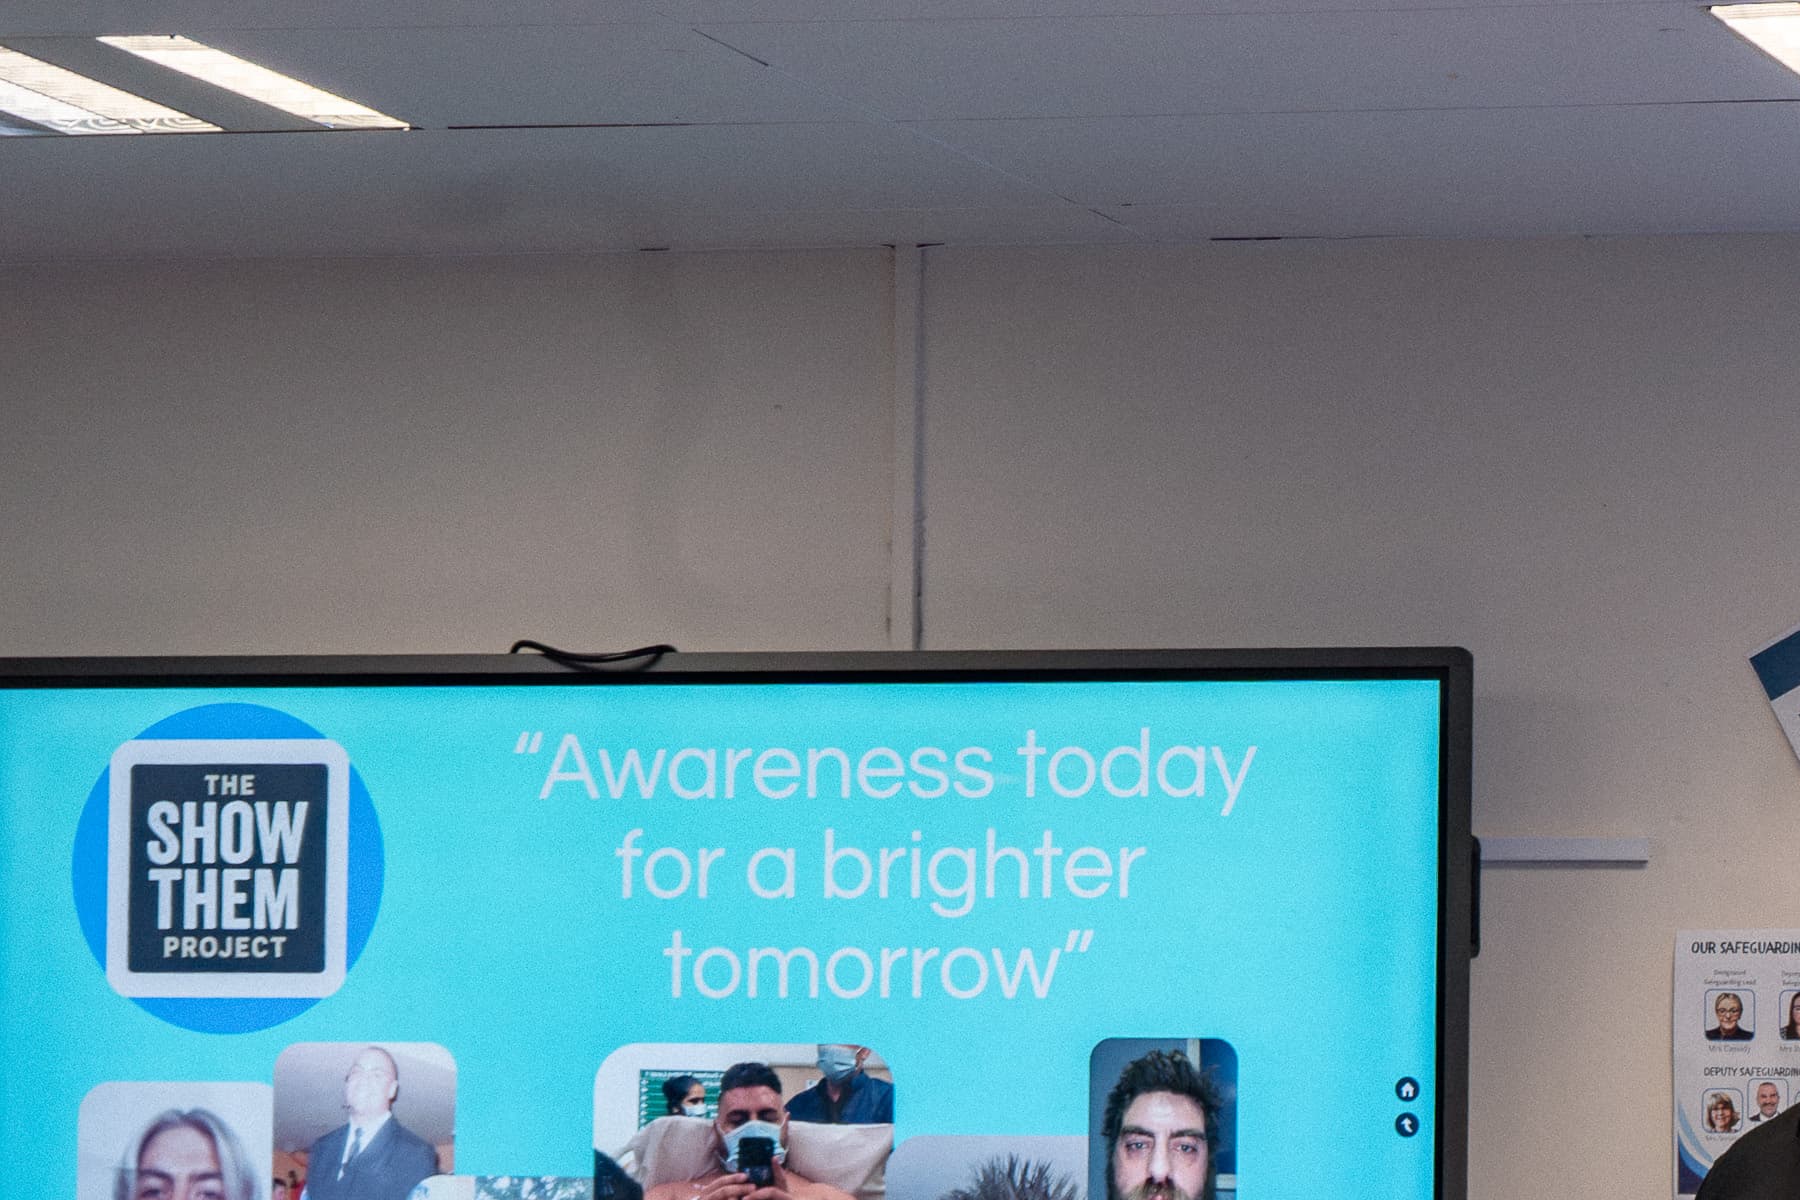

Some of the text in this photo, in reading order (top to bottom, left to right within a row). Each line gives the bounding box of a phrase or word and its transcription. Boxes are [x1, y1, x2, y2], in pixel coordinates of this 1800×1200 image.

[204, 774, 255, 795] THE
[512, 727, 1257, 816] “Awareness today
[146, 800, 309, 865] SHOW
[147, 868, 299, 930] THEM
[615, 828, 1146, 918] for a brighter
[163, 935, 287, 958] PROJECT
[663, 929, 1095, 1000] tomorrow”
[1691, 941, 1716, 954] OUR
[1704, 1067, 1737, 1076] DEPUTY
